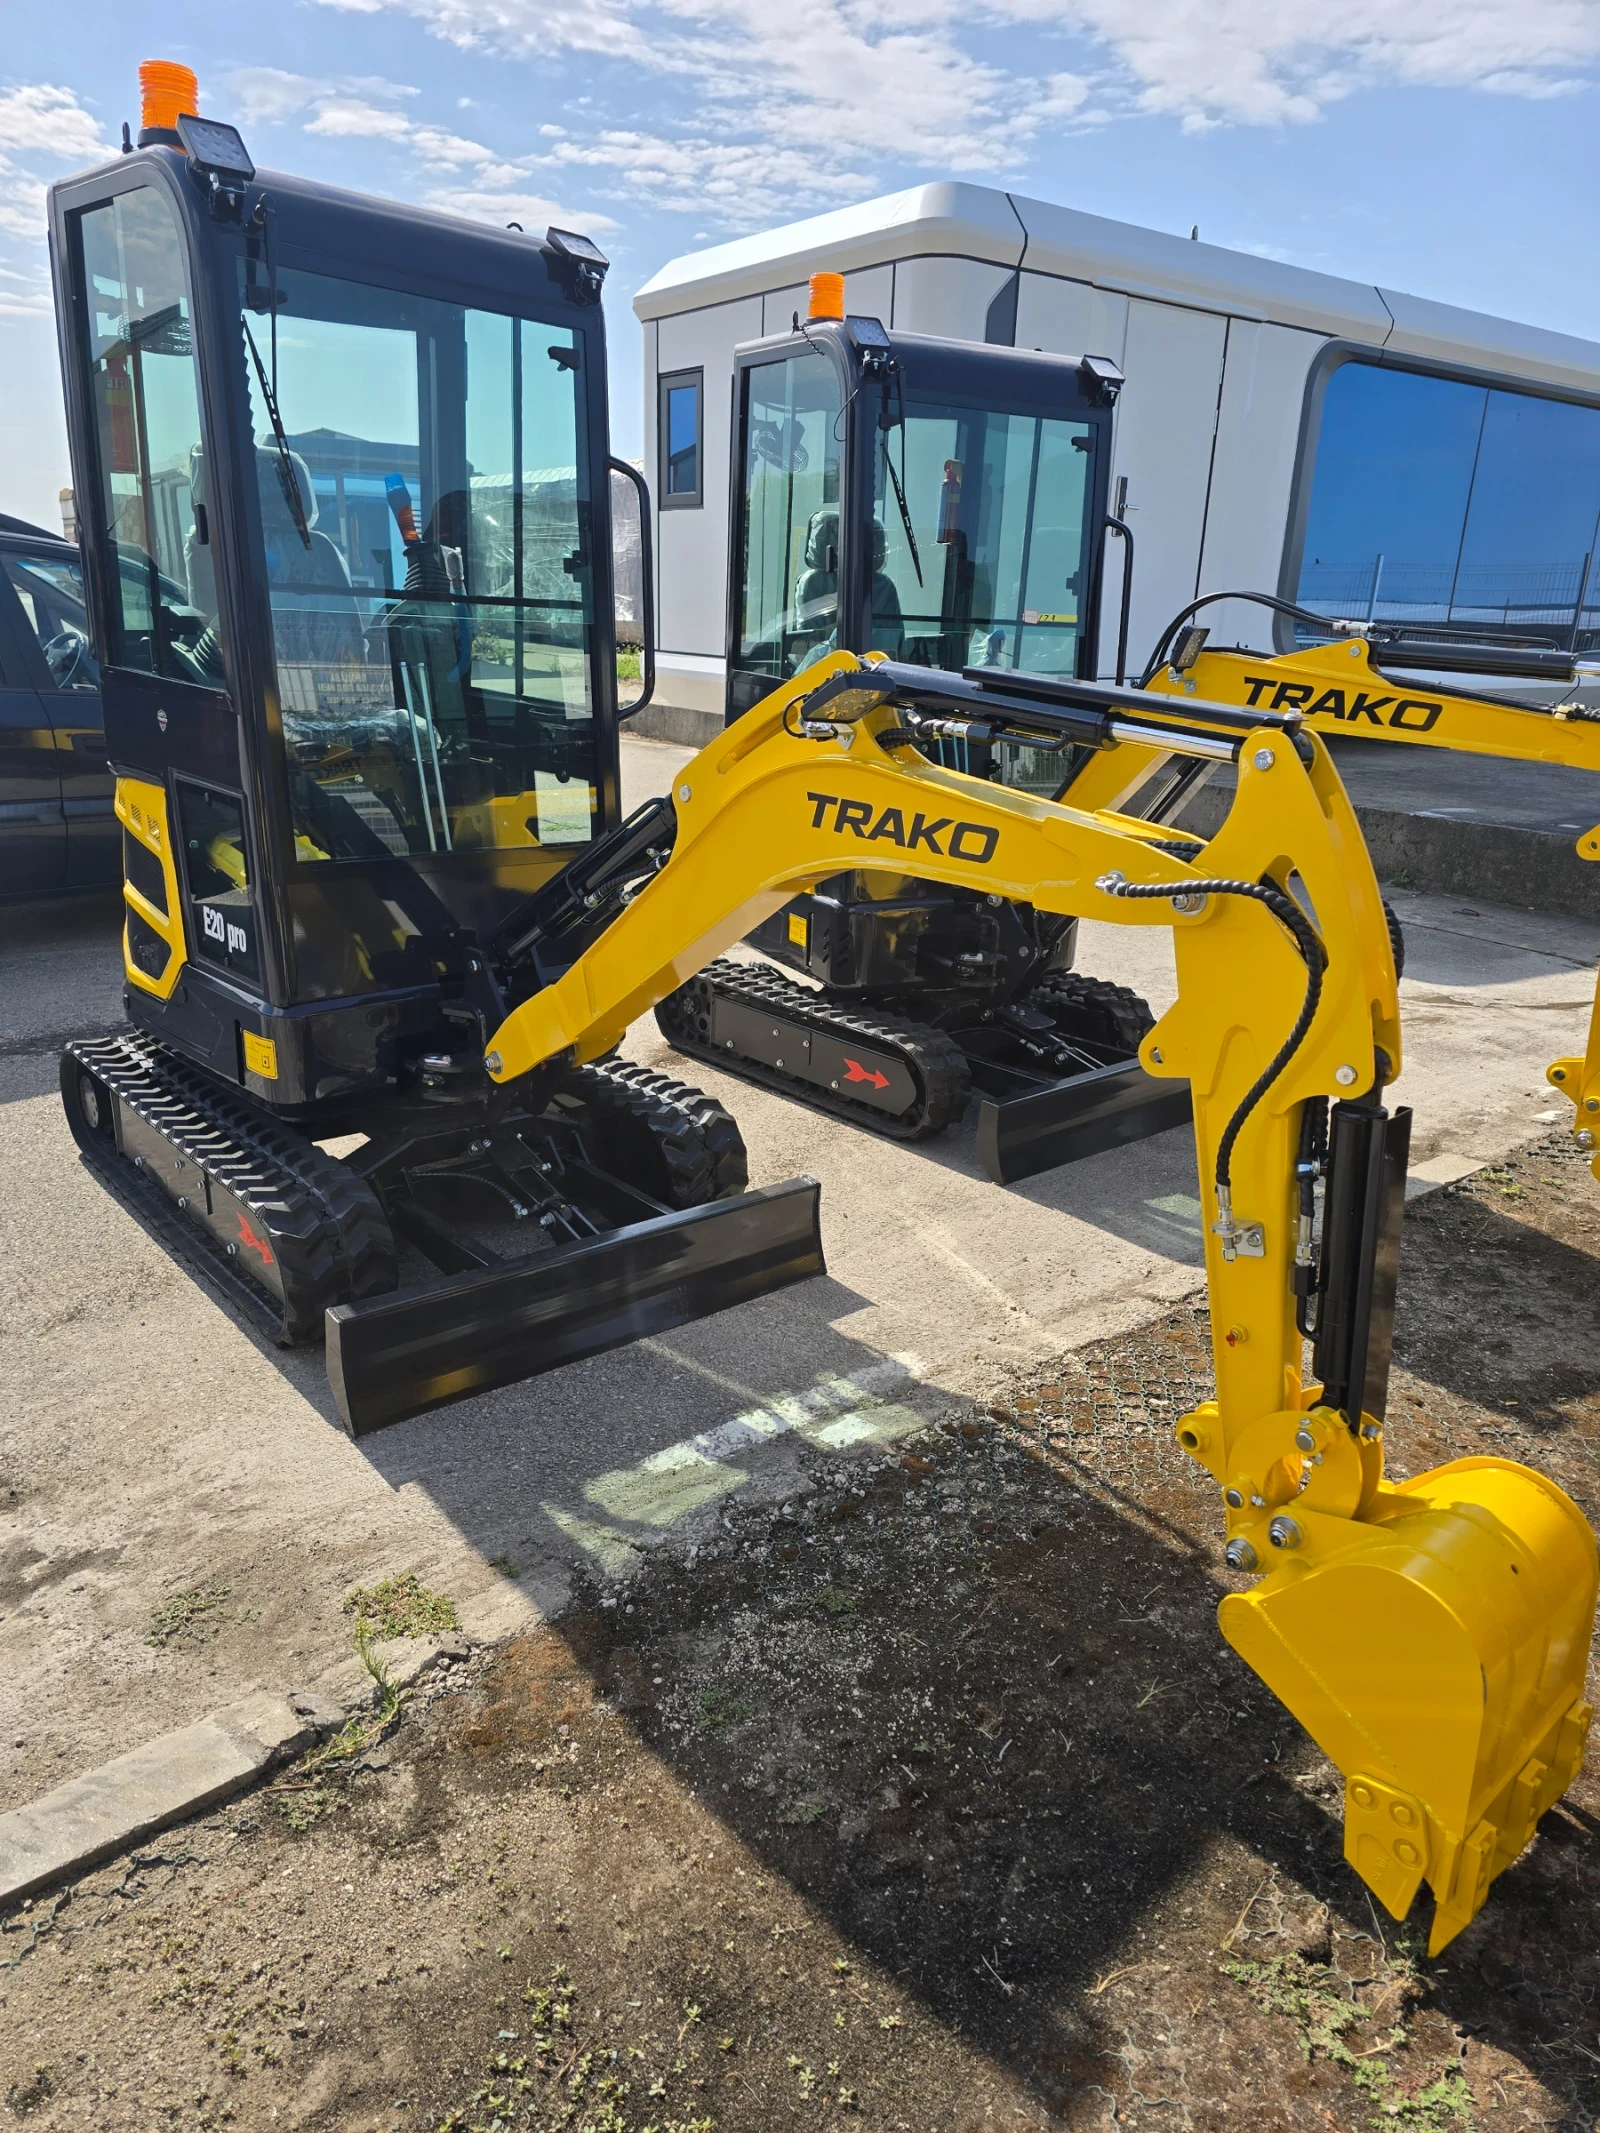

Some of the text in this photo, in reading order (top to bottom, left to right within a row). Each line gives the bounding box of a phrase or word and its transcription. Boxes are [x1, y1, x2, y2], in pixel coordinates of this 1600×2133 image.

[1243, 676, 1443, 732] TRAKO
[806, 791, 1000, 864] TRAKO
[203, 905, 247, 953] E20 pro
